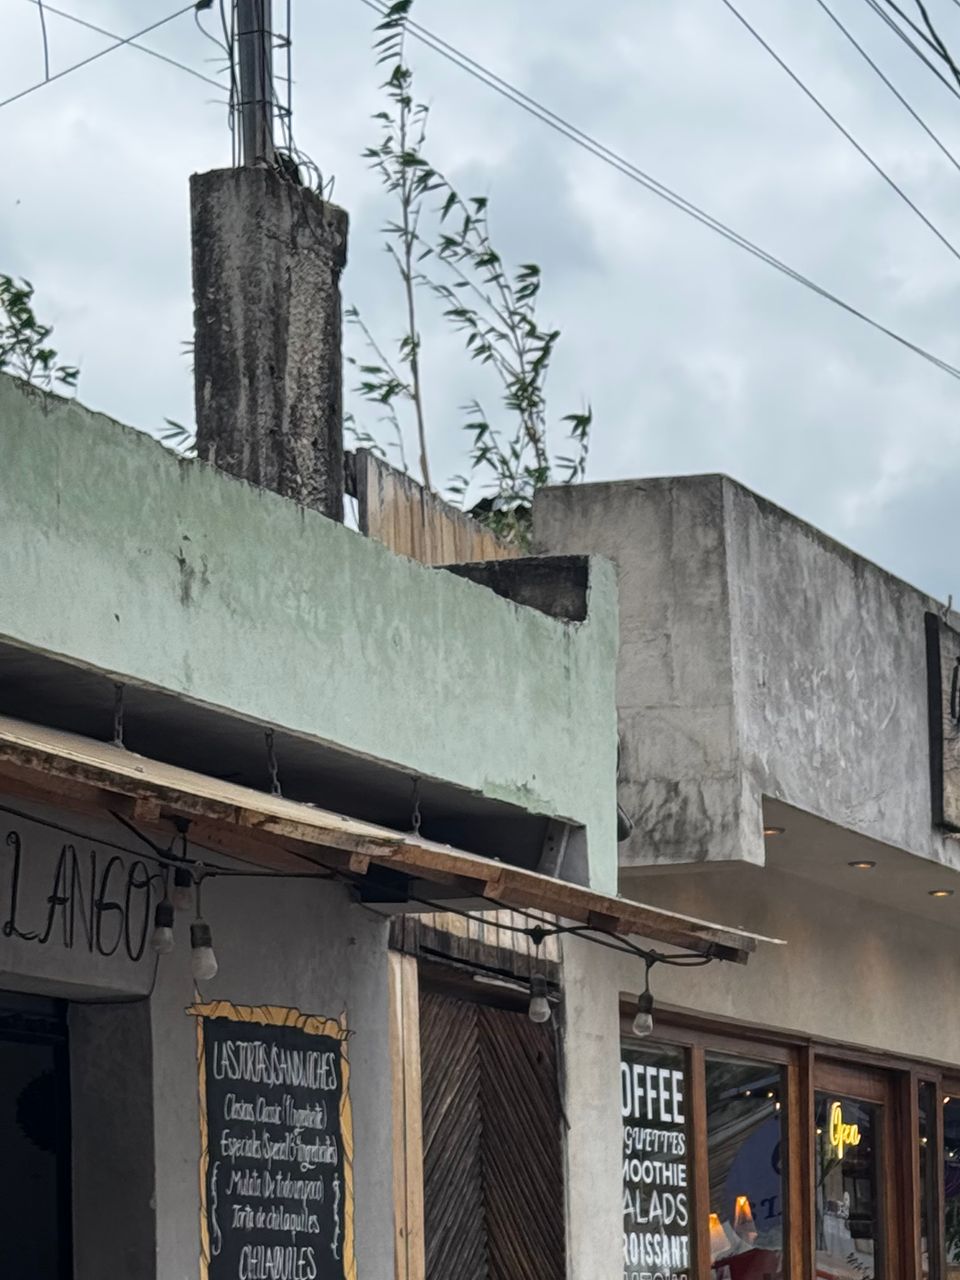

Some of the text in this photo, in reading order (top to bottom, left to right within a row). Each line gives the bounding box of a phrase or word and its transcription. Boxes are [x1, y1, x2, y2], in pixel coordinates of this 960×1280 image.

[620, 1061, 685, 1124] OFFEE
[624, 1125, 686, 1156] GUETTES
[829, 1101, 862, 1160] Open
[623, 1187, 689, 1227] ALADS
[624, 1231, 689, 1268] ROISSANT
